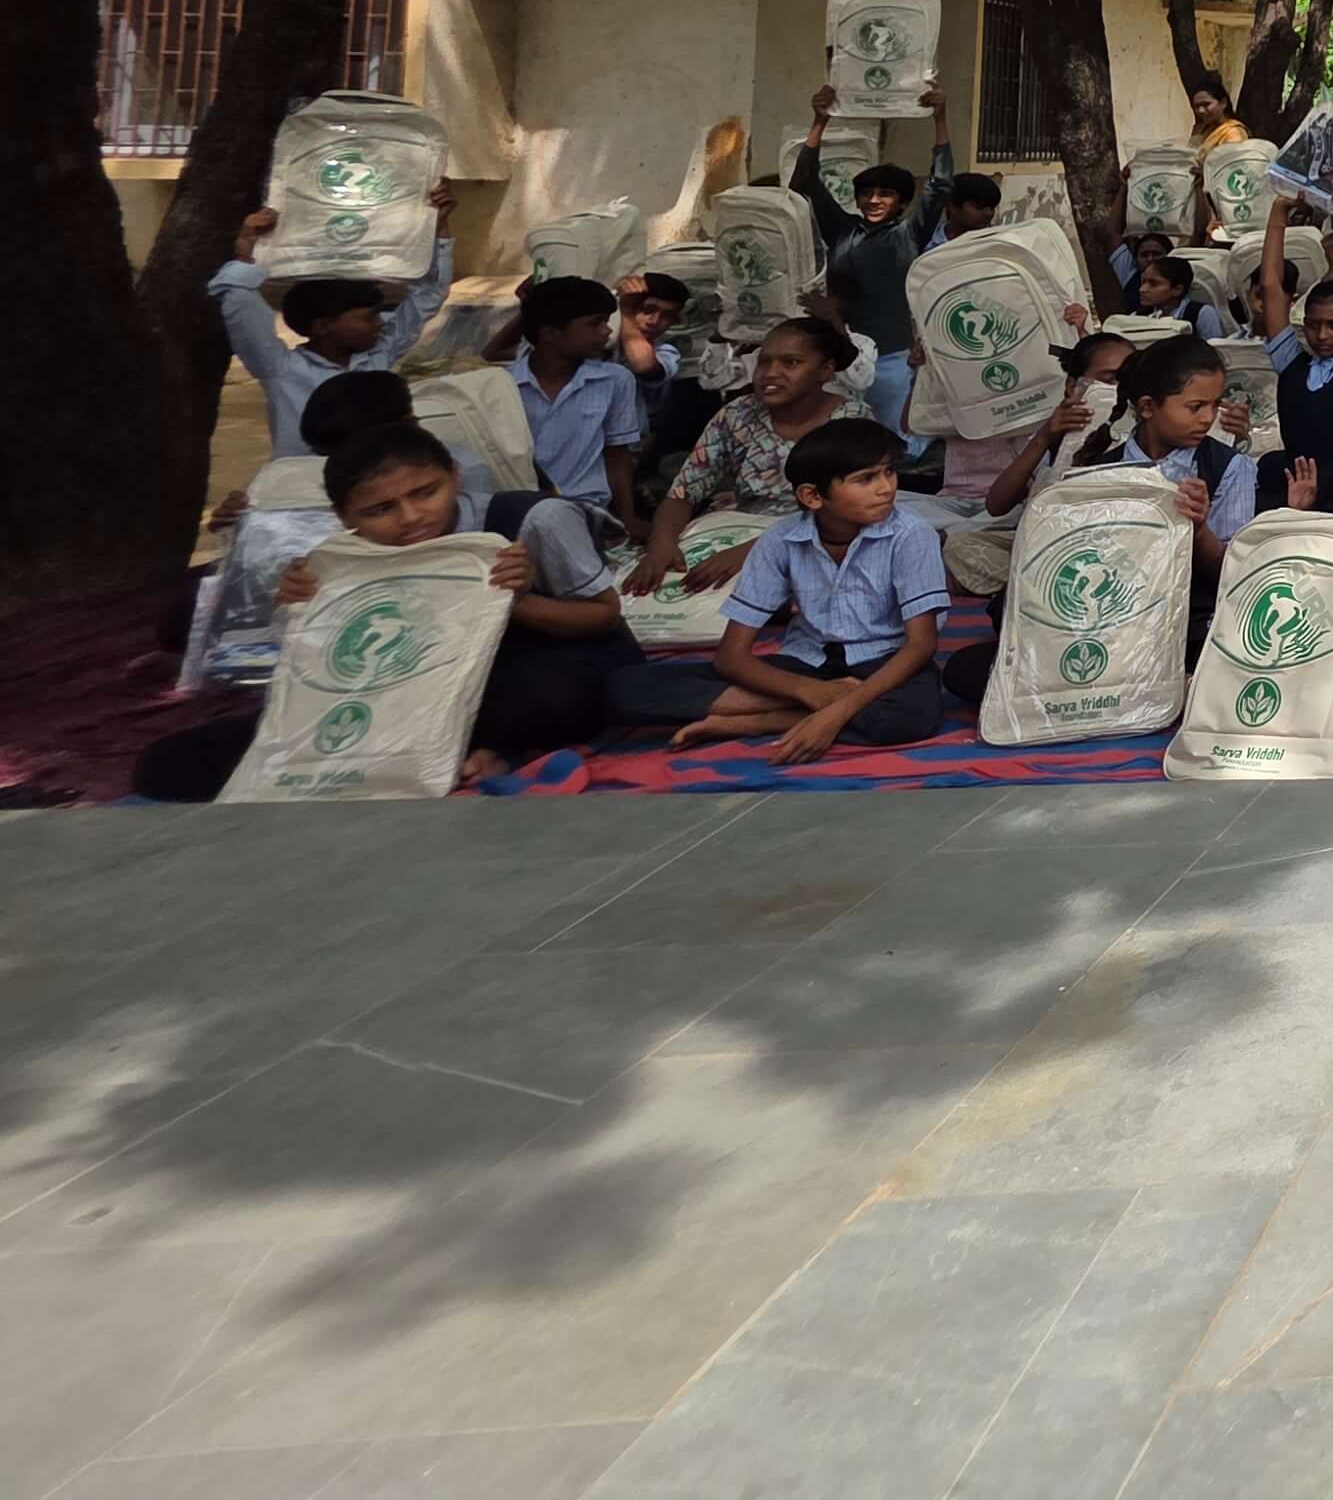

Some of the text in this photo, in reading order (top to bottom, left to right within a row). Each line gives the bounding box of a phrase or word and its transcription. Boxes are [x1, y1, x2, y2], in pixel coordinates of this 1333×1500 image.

[1044, 694, 1120, 715] Sarva Vriddhi
[1210, 745, 1286, 761] Sarva Vriddhi
